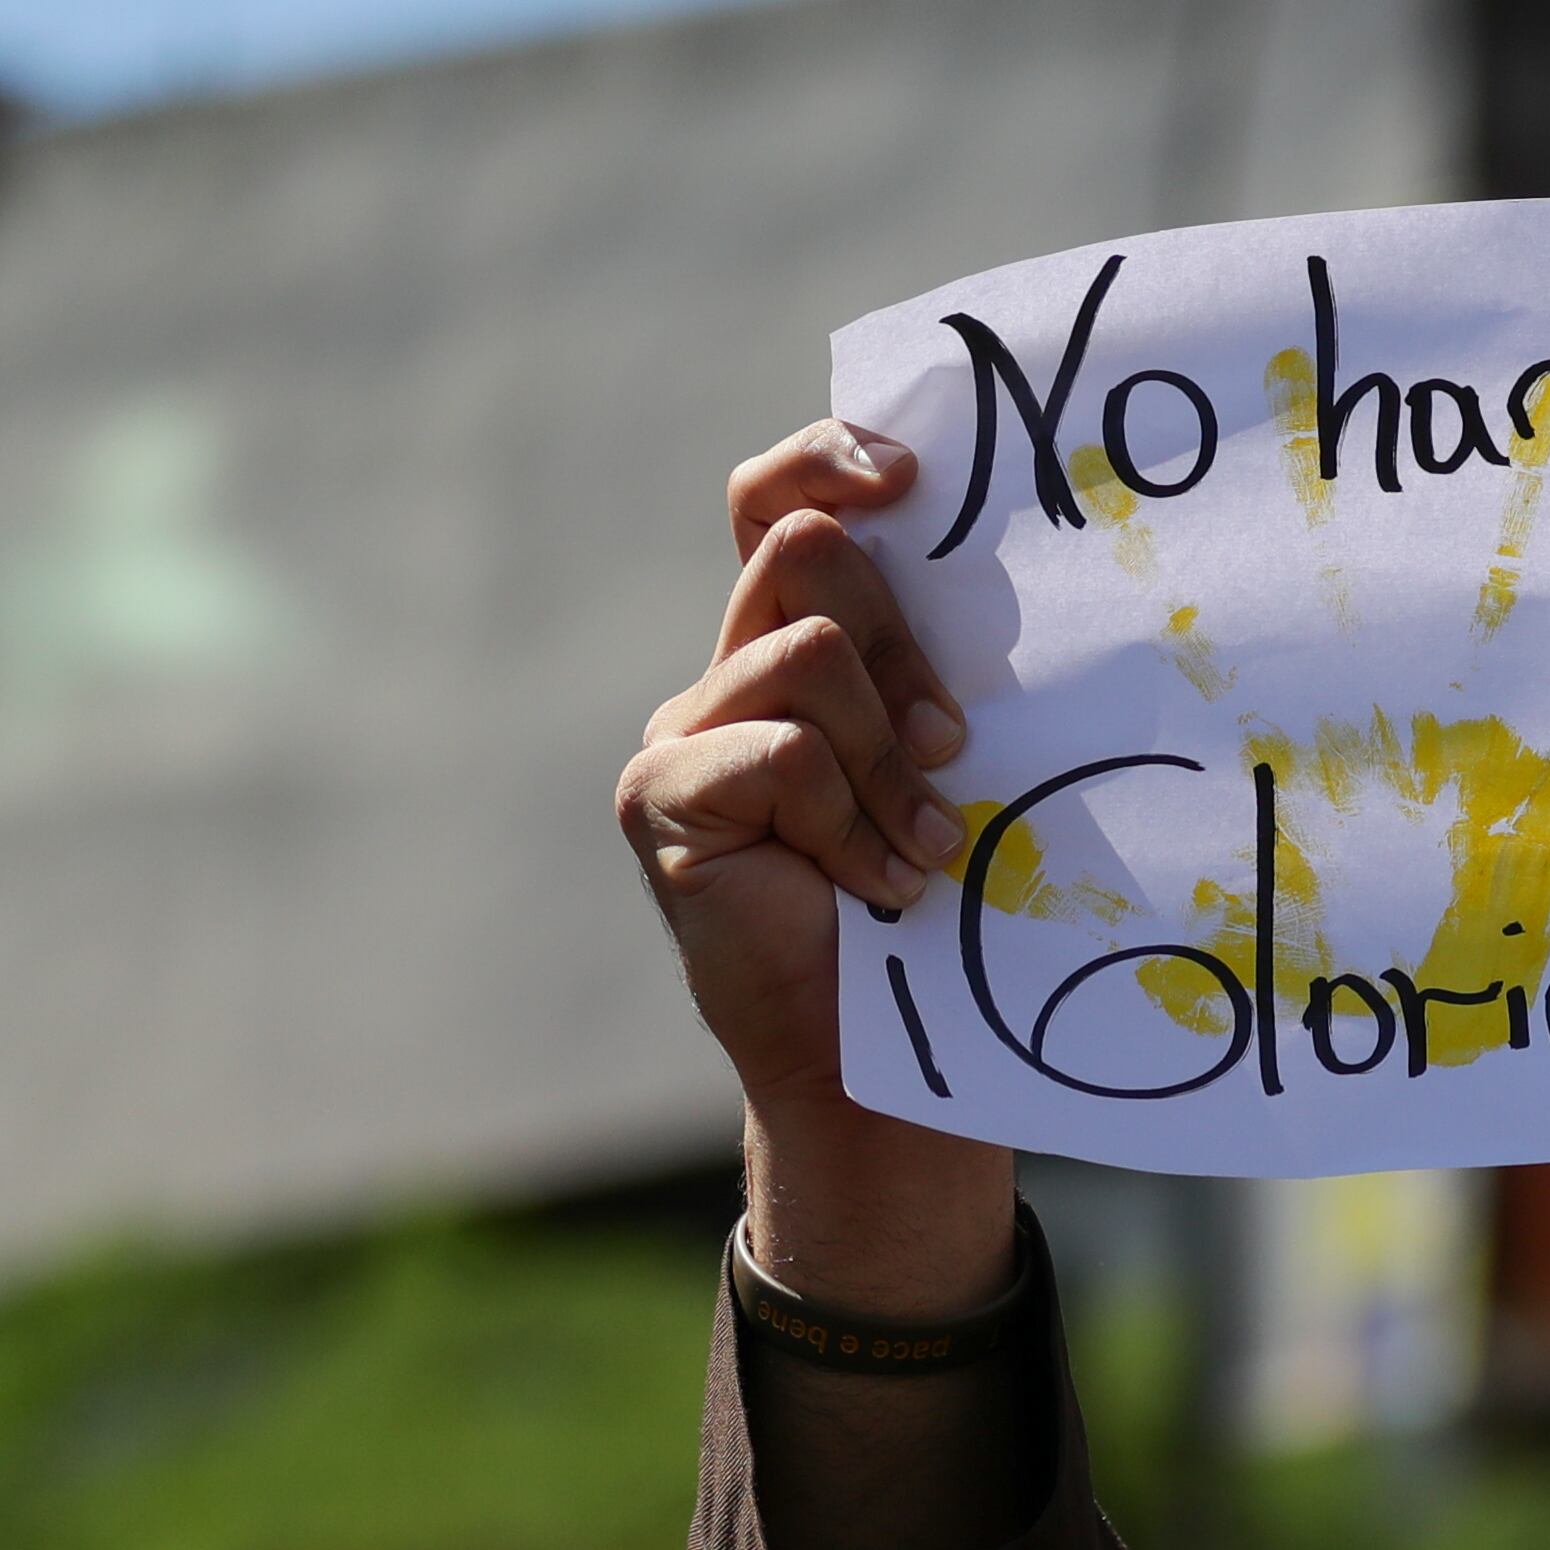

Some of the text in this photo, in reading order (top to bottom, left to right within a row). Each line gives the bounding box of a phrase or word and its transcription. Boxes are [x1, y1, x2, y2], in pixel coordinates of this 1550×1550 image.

[926, 254, 1218, 561] No
[757, 1299, 951, 1360] pace e bene
